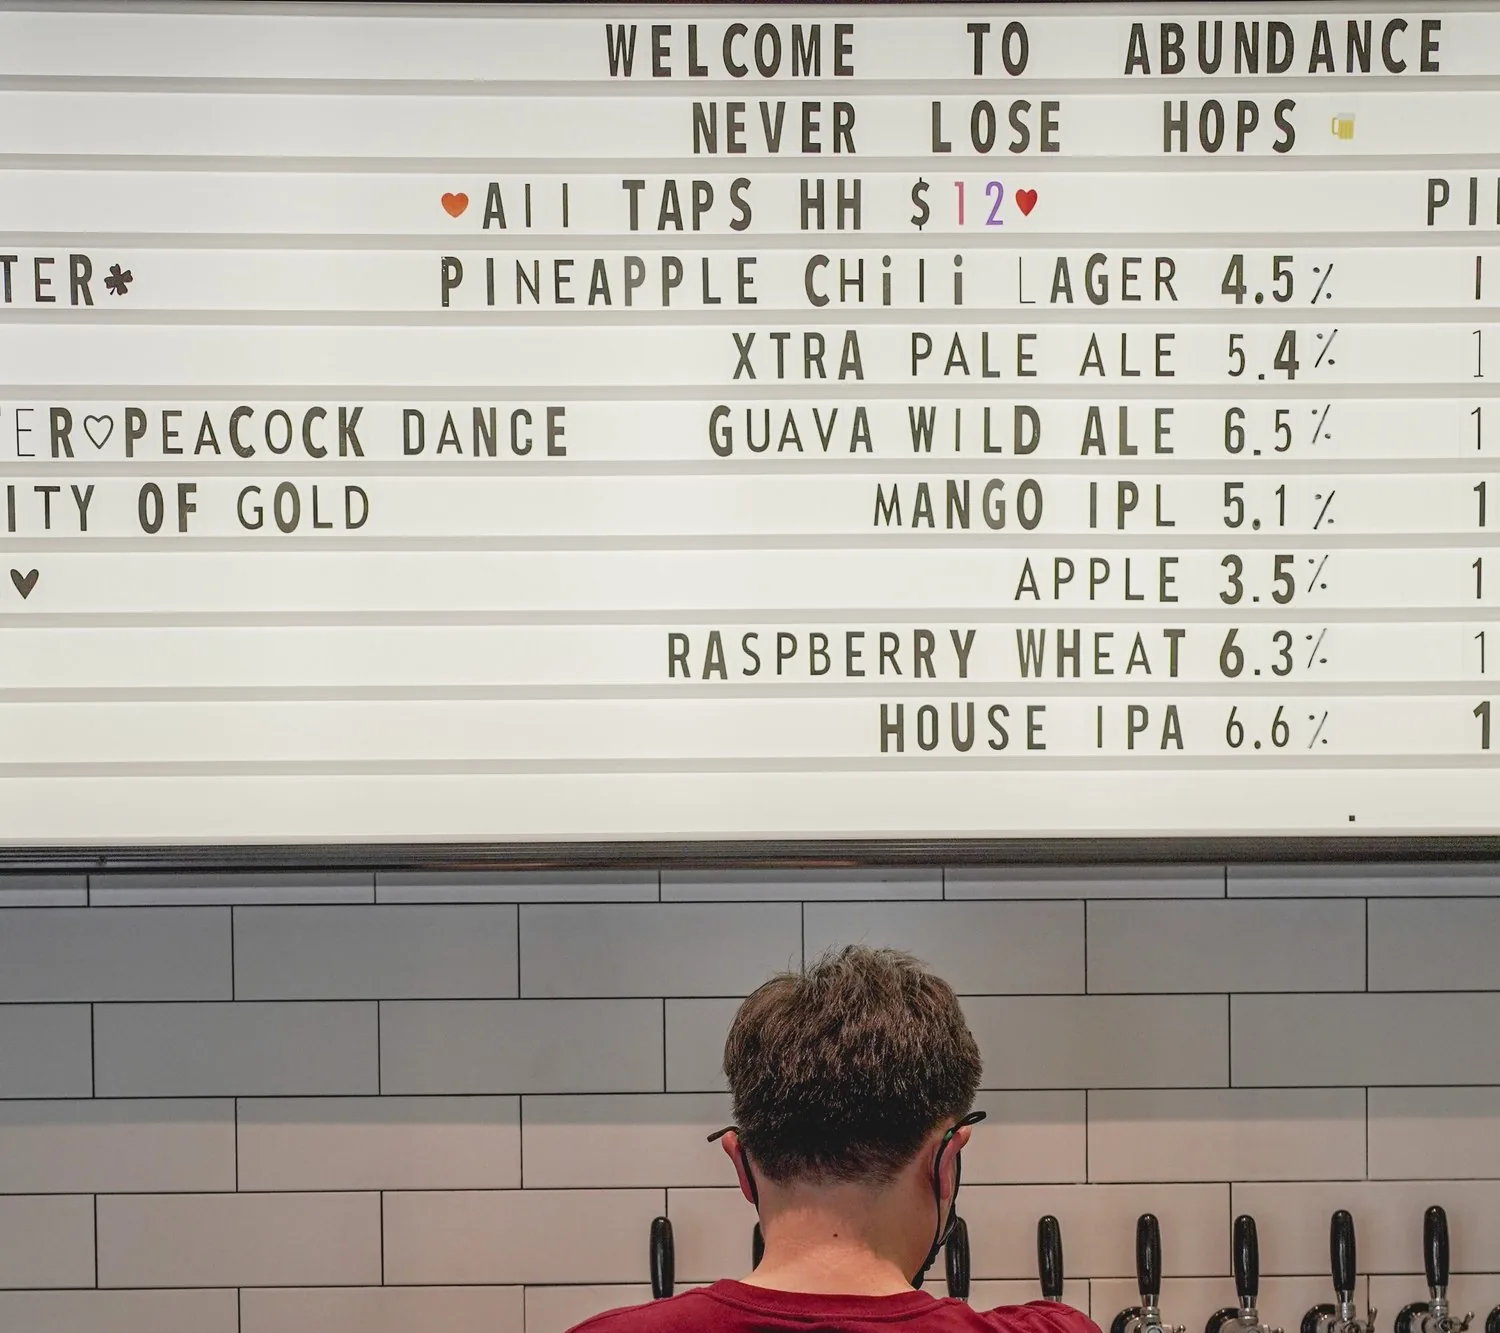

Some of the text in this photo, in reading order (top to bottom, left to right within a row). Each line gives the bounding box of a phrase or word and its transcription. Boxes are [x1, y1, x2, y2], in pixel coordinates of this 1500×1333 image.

[605, 18, 1442, 79] WELCOME TO ABUNDANCE
[692, 98, 1297, 154] NEVER LOSE HOPS
[622, 177, 752, 232] TAPS
[800, 178, 862, 231] HH
[910, 176, 1005, 232] $12
[1427, 176, 1500, 227] PI
[441, 255, 758, 308] PINEAPPLE
[1019, 252, 1178, 306] LAGER
[731, 329, 865, 381] XTRA
[911, 330, 1037, 379] PALE
[1079, 331, 1176, 378] ALE
[1472, 328, 1485, 379] 1
[124, 404, 366, 459] PEACOCK
[402, 405, 568, 458] DANCE
[708, 403, 874, 459] GUAVA
[907, 405, 1041, 455] WILD
[1080, 404, 1174, 456] ALE
[1470, 406, 1483, 452] 1
[6, 480, 369, 535] ITY OF GOLD
[873, 477, 1043, 531] MANGO
[1089, 480, 1176, 531] IPL
[1473, 480, 1487, 528] 1
[1014, 556, 1180, 604] APPLE
[1472, 557, 1484, 601] 1
[668, 629, 977, 680] RASPBERRY
[1015, 628, 1186, 679] WHEAT
[1474, 630, 1486, 674] 1
[880, 701, 1047, 753] HOUSE
[1096, 703, 1184, 751] IPA
[1472, 700, 1492, 750] 1
